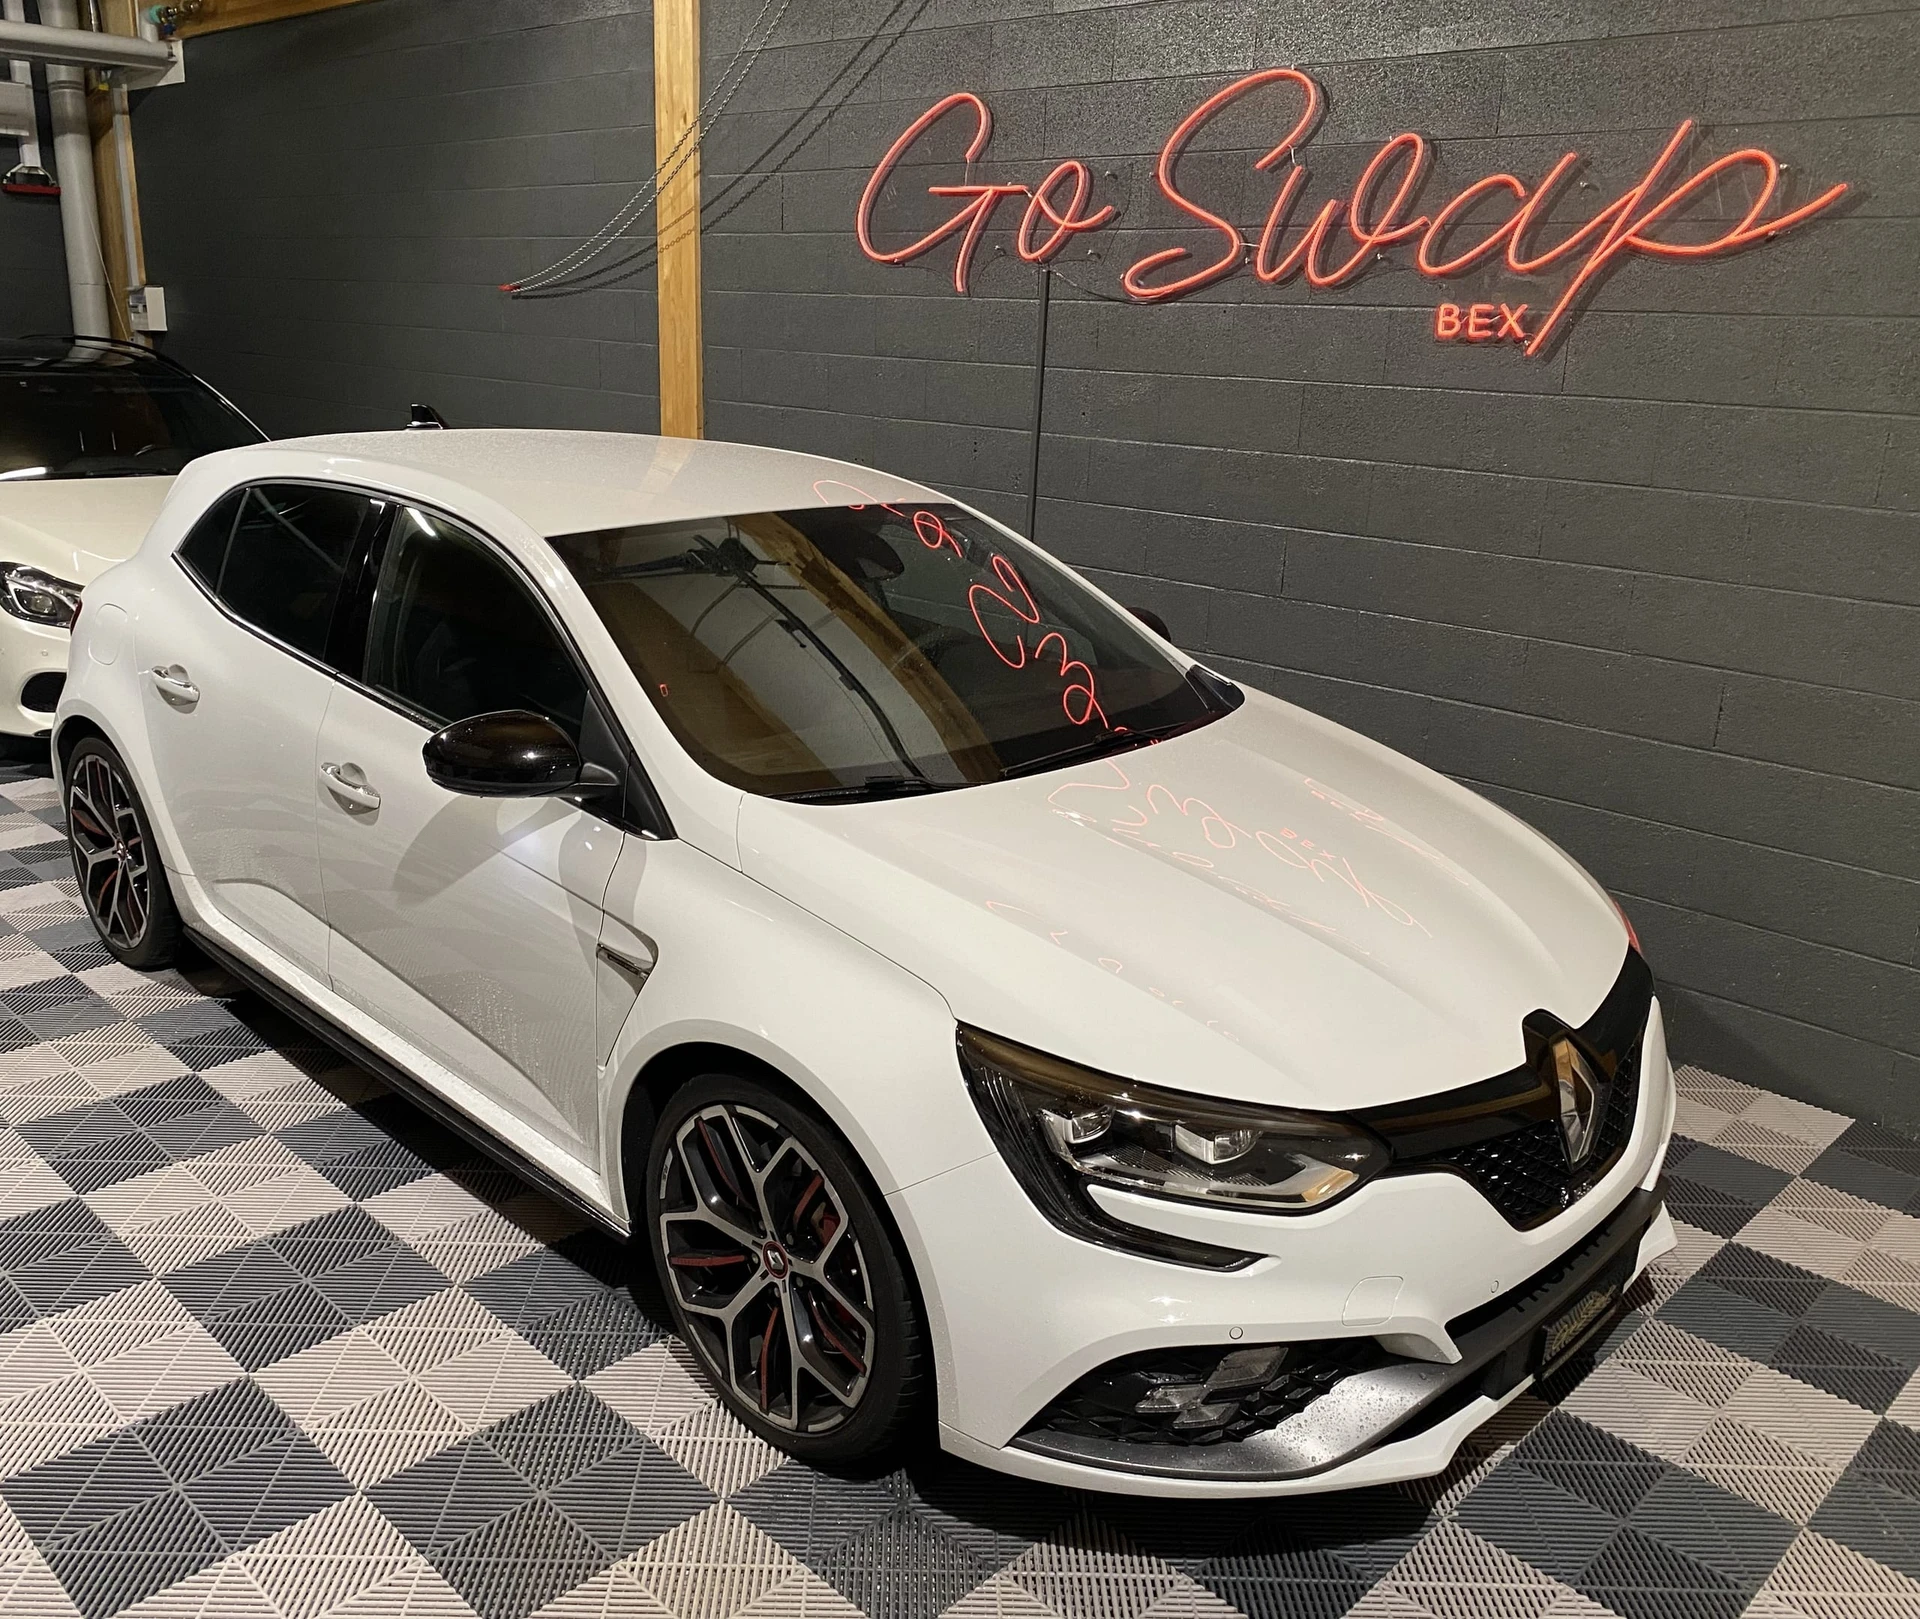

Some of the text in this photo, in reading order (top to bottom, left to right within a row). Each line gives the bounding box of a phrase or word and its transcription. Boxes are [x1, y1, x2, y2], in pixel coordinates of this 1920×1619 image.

[857, 69, 1847, 356] Go Swap
[1435, 302, 1529, 338] BEX
